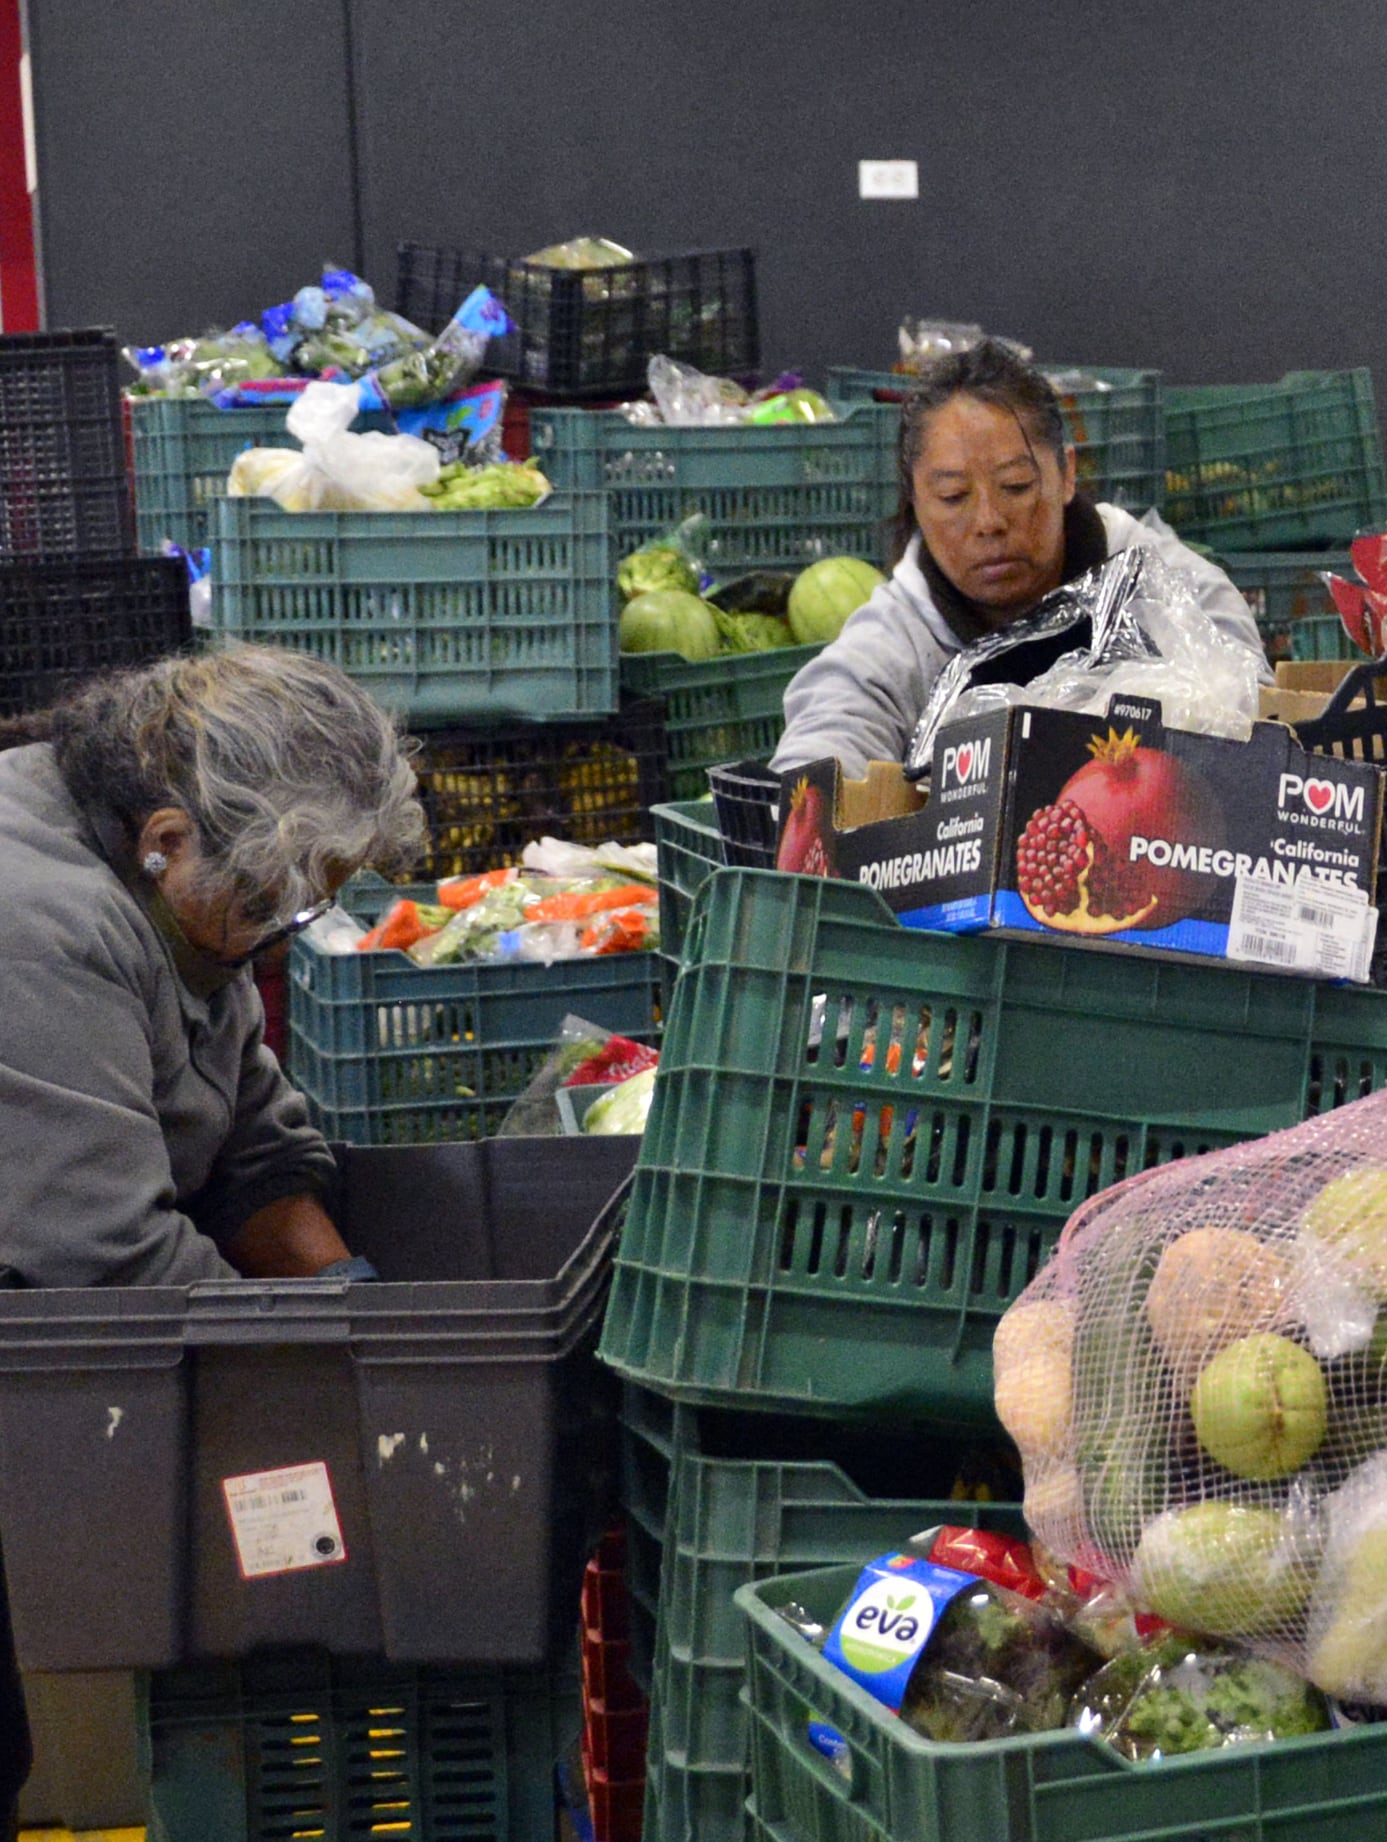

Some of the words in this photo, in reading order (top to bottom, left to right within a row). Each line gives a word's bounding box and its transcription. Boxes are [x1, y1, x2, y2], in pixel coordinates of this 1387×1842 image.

[940, 736, 992, 789] POM
[939, 781, 987, 804] WONDERFUL
[1277, 772, 1365, 822] POM
[936, 810, 985, 842] California
[1276, 809, 1361, 835] WONDERFUL
[859, 838, 983, 891] POMEGRANATES
[1273, 837, 1360, 868] California
[855, 1605, 919, 1642] eva
